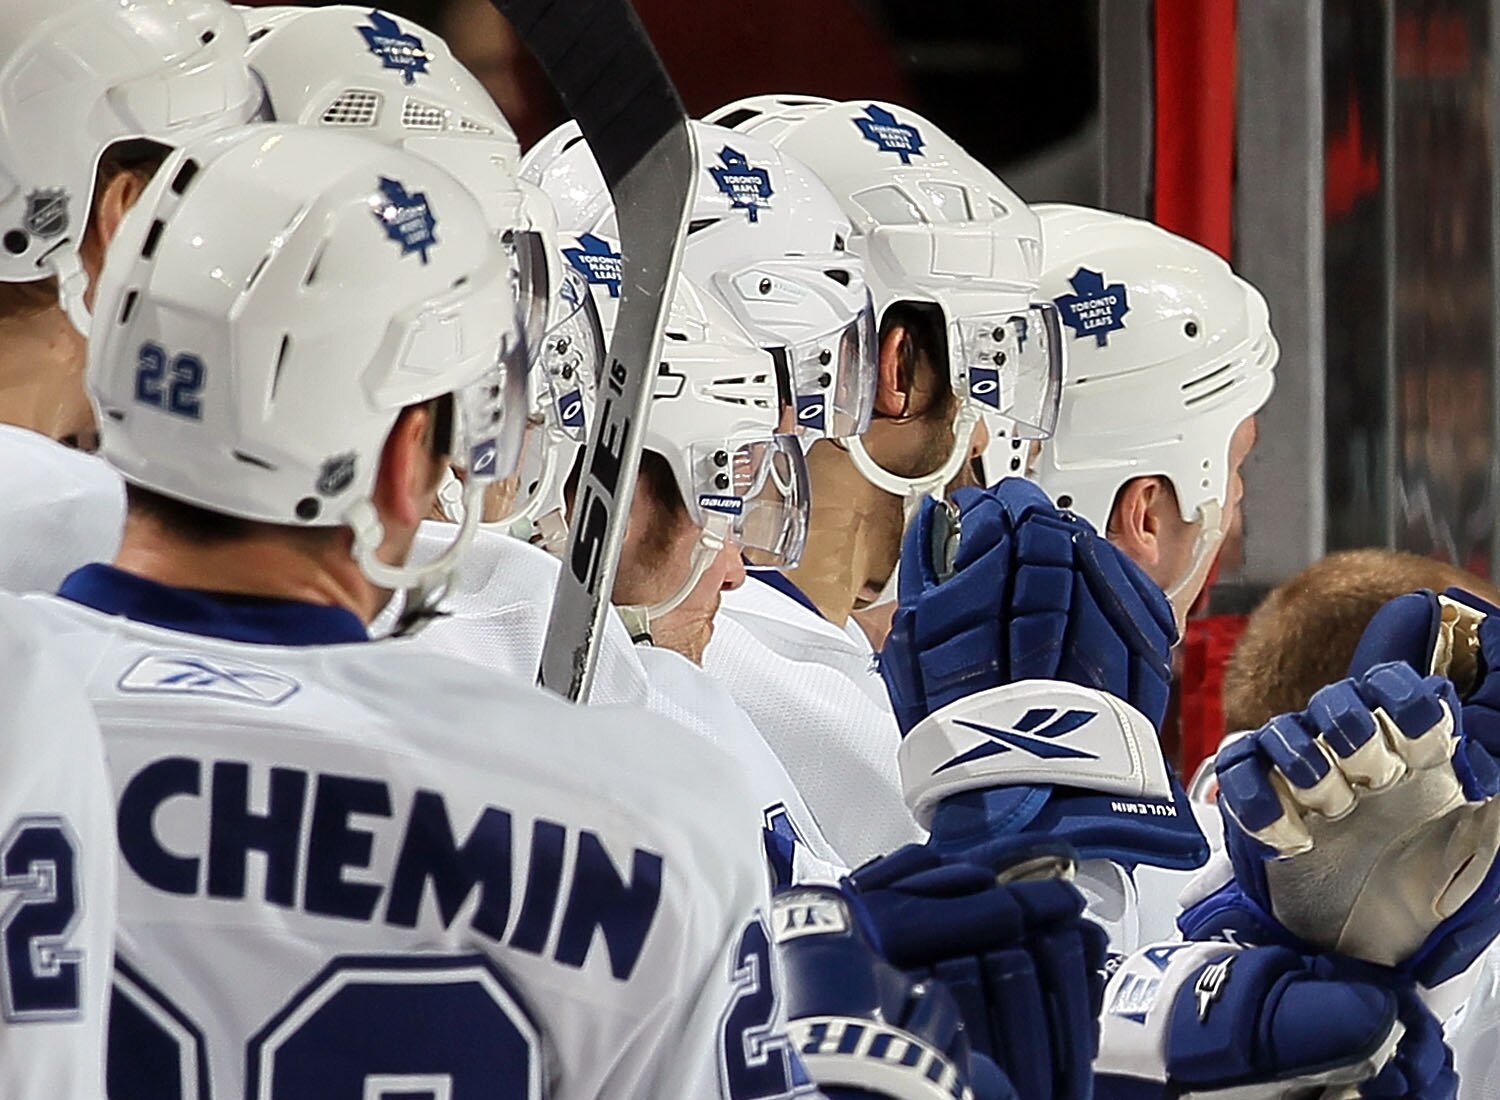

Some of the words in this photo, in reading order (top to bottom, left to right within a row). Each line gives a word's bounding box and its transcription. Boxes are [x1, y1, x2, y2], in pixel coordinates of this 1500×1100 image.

[1070, 295, 1117, 313] TORONTO
[1080, 306, 1112, 320] MAPLE
[1084, 316, 1113, 329] LEAFS
[135, 342, 205, 420] 22
[1111, 801, 1177, 817] KULEMIN
[116, 756, 664, 982] CHEMIN
